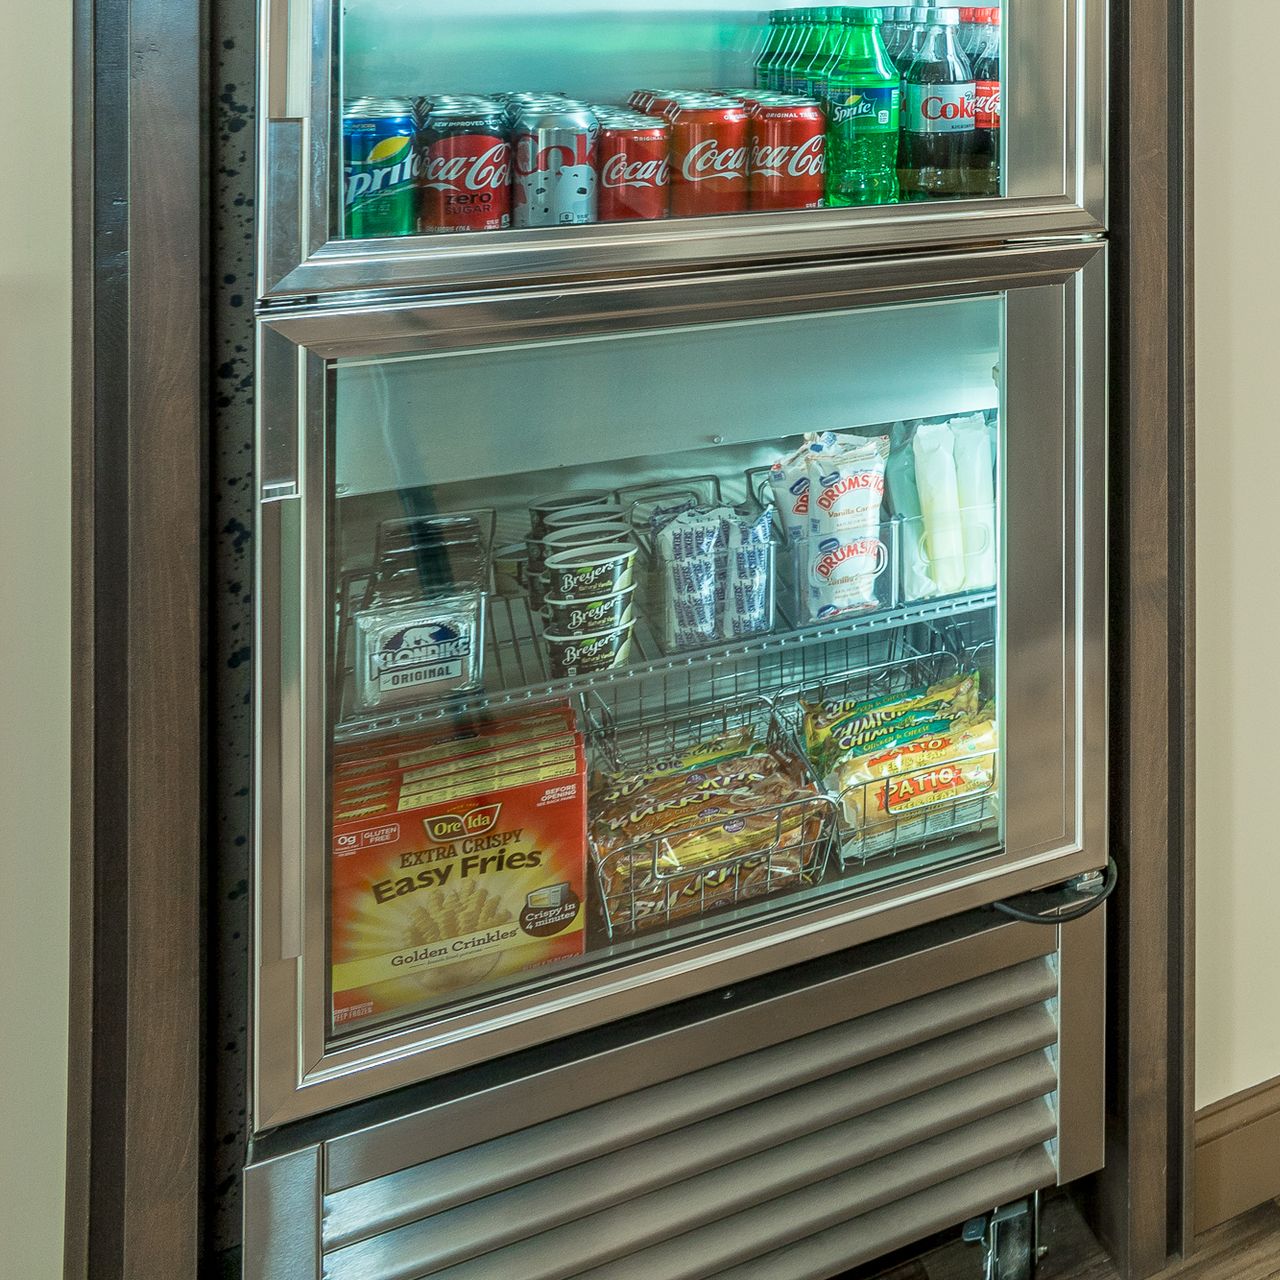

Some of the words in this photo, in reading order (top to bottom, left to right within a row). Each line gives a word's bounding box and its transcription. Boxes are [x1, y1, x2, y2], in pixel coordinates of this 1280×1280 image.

[765, 111, 798, 119] ORIGINAL
[832, 101, 873, 122] Sprite
[448, 119, 484, 127] IMPROVED
[446, 191, 493, 205] zero
[447, 204, 492, 214] SUGAR
[828, 506, 855, 519] Vanilla
[561, 561, 614, 593] Breyers
[370, 638, 471, 673] KLONDIKE
[562, 632, 616, 666] Breyers
[391, 665, 453, 686] ORIGINAL
[545, 783, 577, 796] BEFORE
[884, 767, 954, 800] PATIO
[541, 789, 577, 802] OPENING
[364, 826, 397, 839] GLUTEN
[434, 820, 462, 837] Ore
[467, 814, 491, 829] Ida
[369, 834, 391, 844] FREE
[400, 844, 460, 870] EXTRA
[462, 829, 524, 855] CRISPY
[372, 863, 454, 905] Easy
[460, 849, 542, 879] Fries
[525, 907, 564, 925] Crispy
[564, 902, 576, 911] in
[525, 921, 534, 931] 4
[535, 910, 577, 928] minutes
[391, 946, 449, 967] Golden
[451, 928, 519, 952] Crinkles
